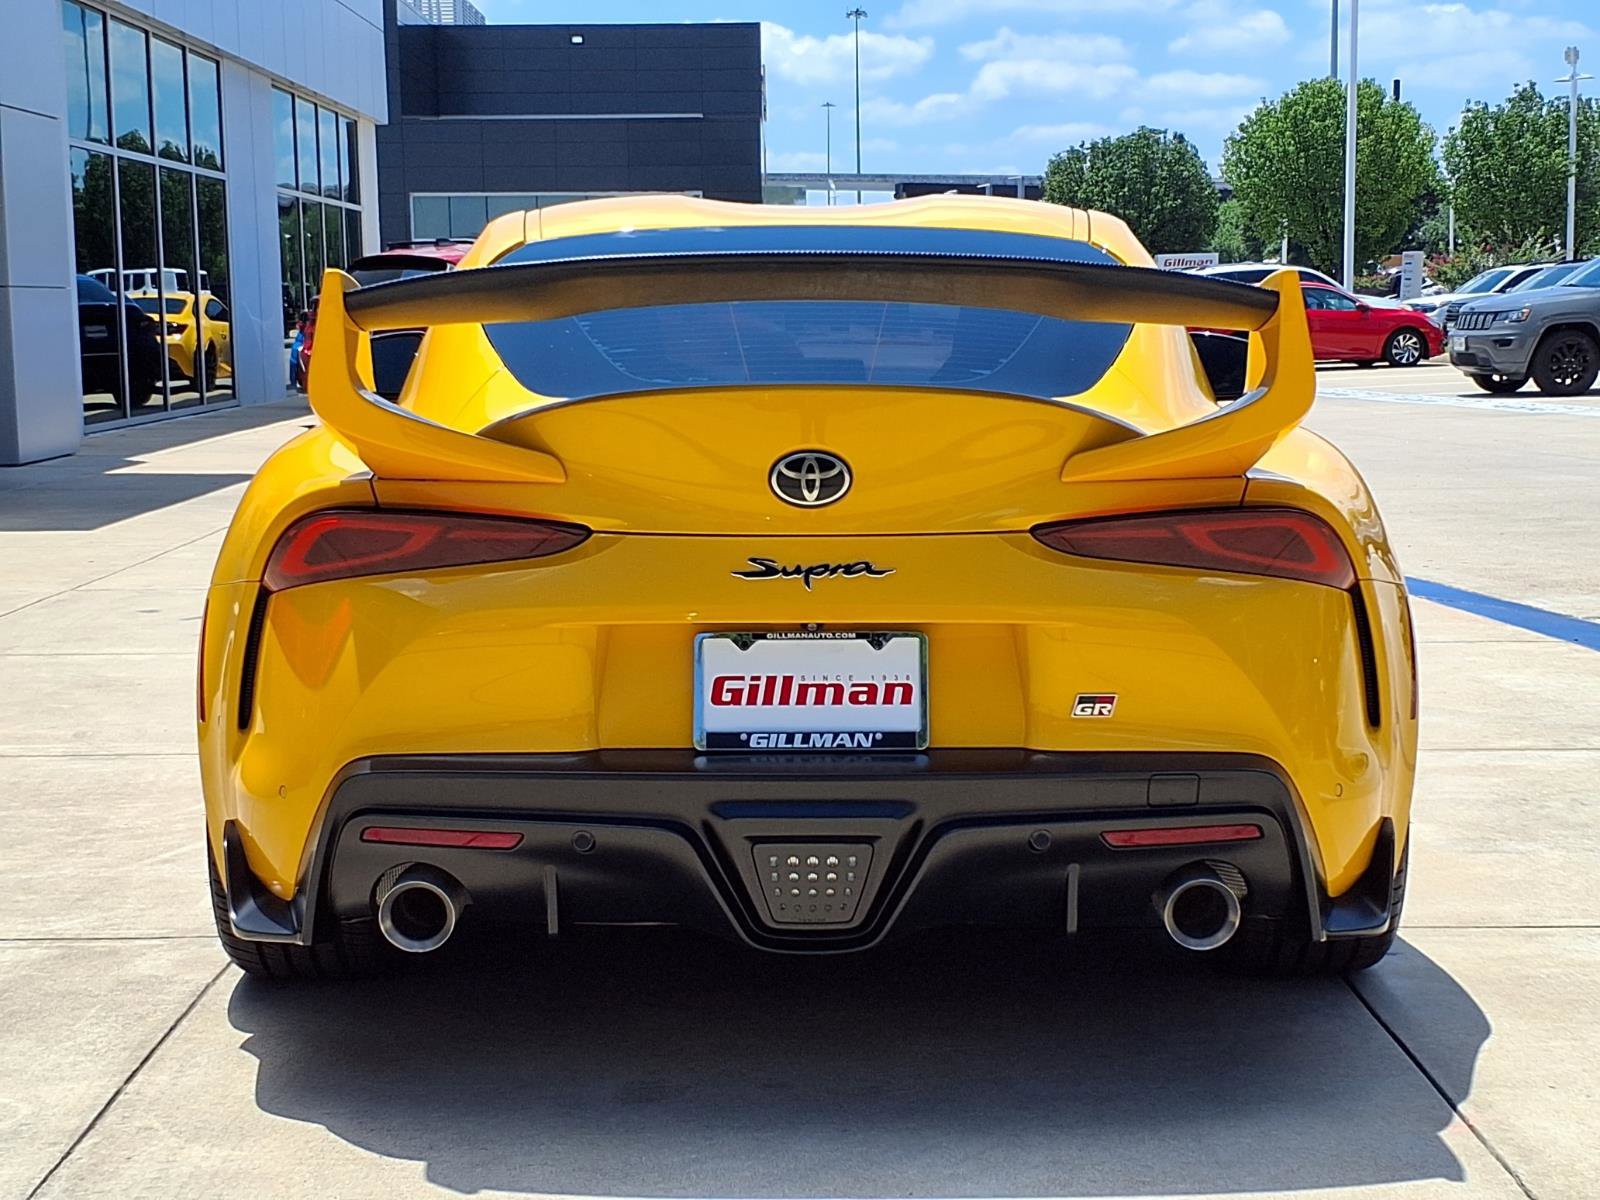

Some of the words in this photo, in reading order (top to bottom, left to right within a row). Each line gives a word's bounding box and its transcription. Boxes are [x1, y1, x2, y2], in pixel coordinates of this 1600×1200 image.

[1163, 258, 1213, 267] Gillman
[731, 557, 896, 592] Supra
[766, 632, 856, 640] GILLMANAUTO.COM
[710, 675, 913, 706] Gillman
[1075, 703, 1113, 716] GR
[750, 733, 873, 748] GILLMAN
